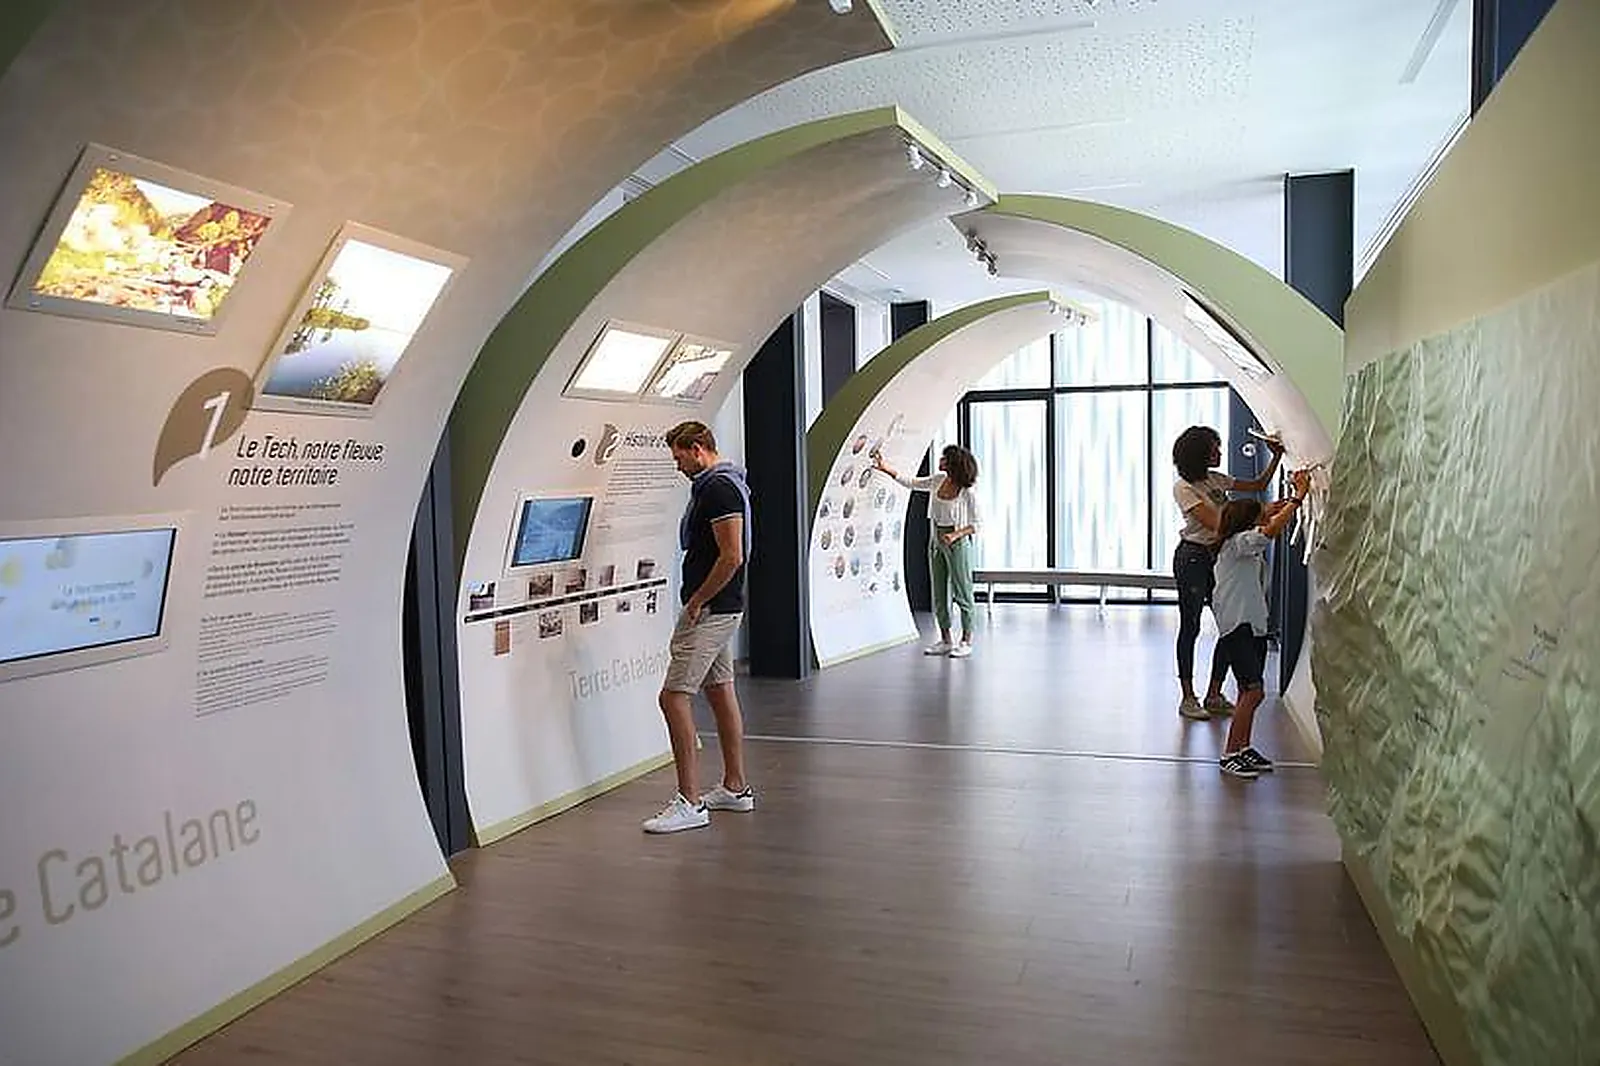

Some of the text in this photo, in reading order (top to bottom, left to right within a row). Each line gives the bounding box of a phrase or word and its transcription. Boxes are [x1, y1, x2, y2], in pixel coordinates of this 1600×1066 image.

[201, 391, 231, 460] 1
[236, 434, 258, 459] Le
[303, 441, 341, 460] notre
[228, 467, 273, 486] notre
[568, 669, 610, 700] Terre
[37, 798, 261, 926] Catalane
